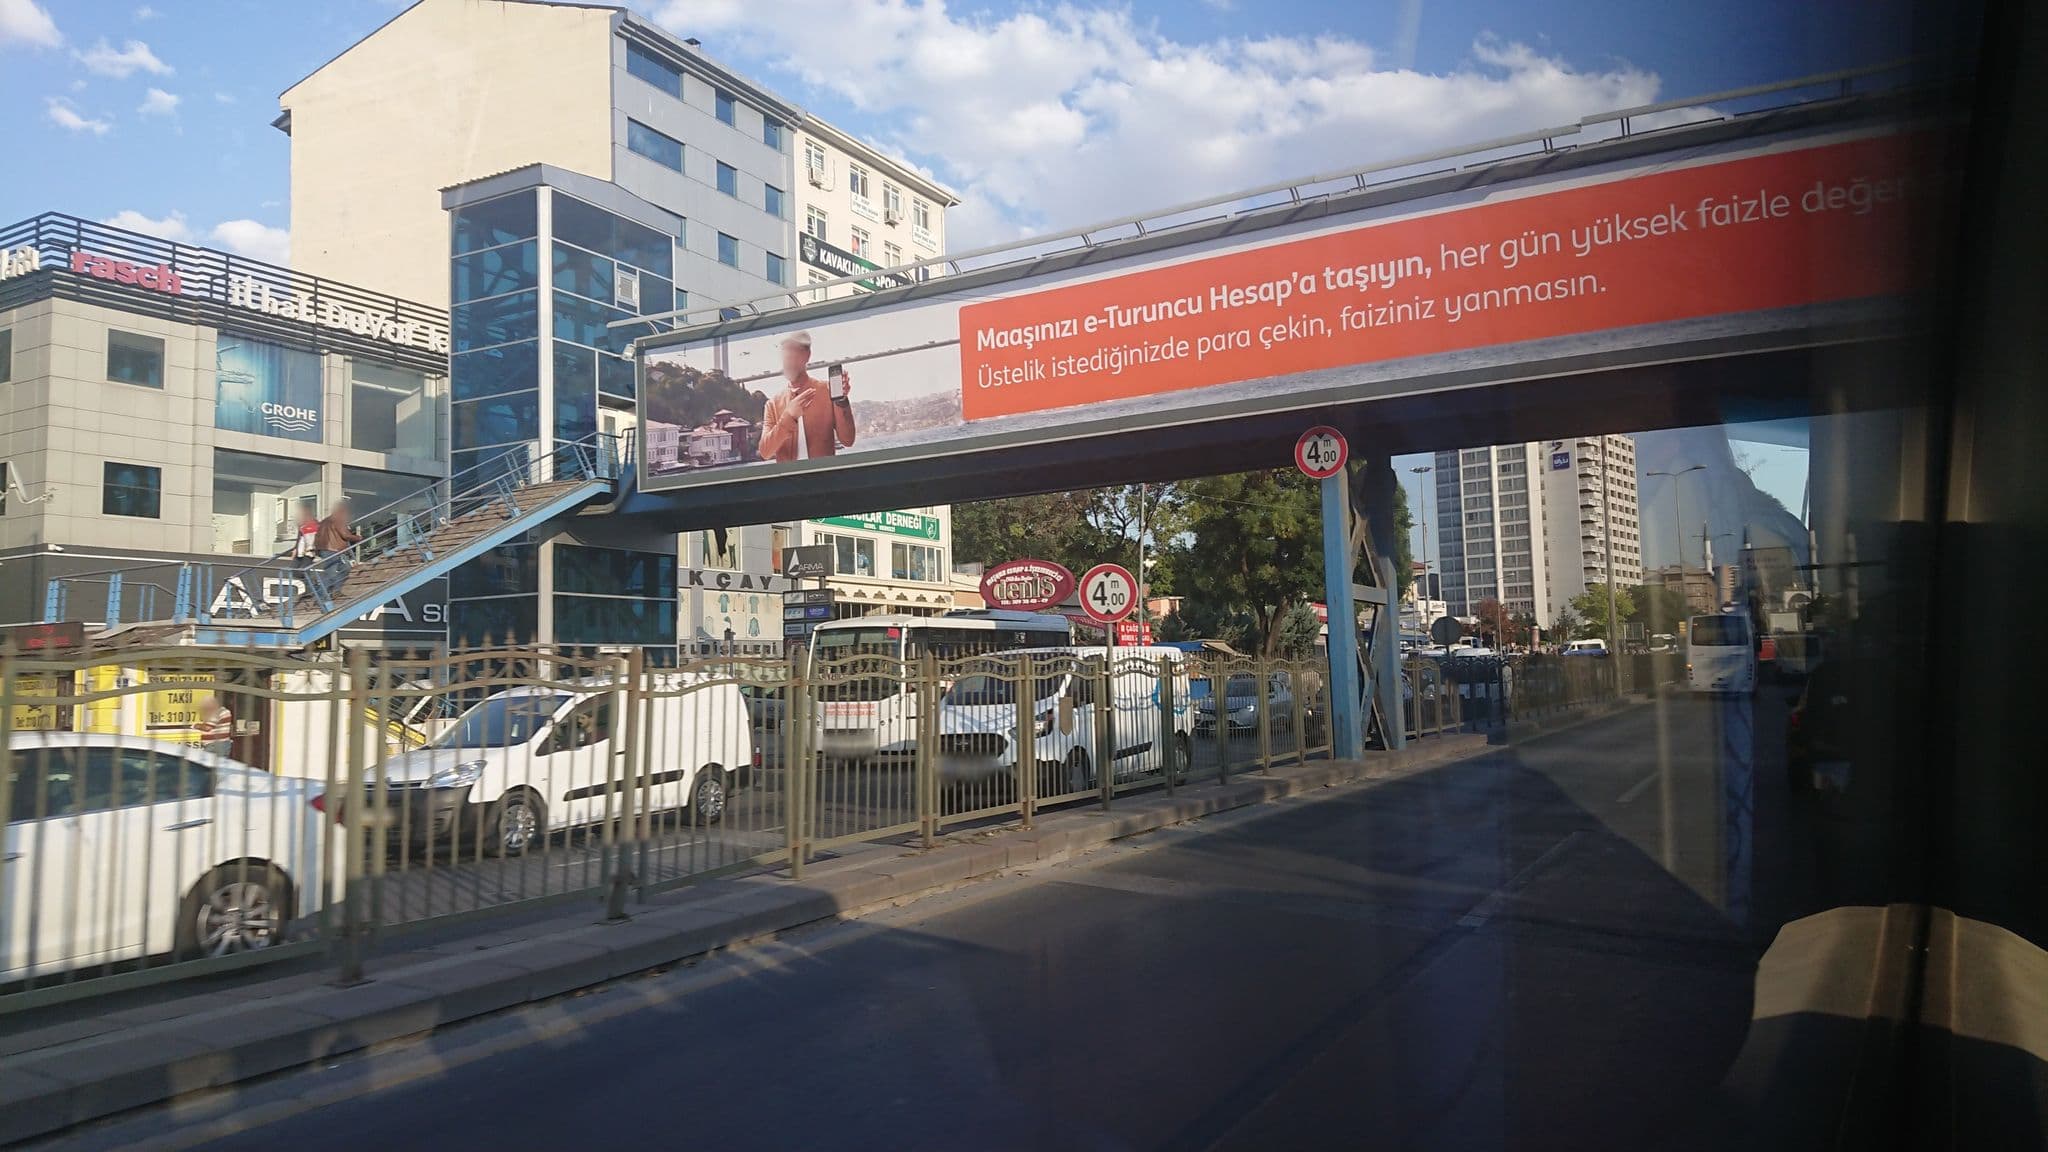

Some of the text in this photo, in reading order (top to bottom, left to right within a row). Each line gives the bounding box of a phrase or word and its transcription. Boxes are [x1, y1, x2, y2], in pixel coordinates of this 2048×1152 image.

[71, 250, 182, 295] rasch
[977, 318, 1078, 351] Maaşınızı
[1084, 295, 1203, 334] e-Turuncu
[1210, 271, 1317, 311] Hesap'a
[1323, 256, 1432, 292] taşıyın,
[1440, 243, 1491, 272] her
[1500, 230, 1561, 269] gün
[1571, 203, 1689, 258] yüksek
[1696, 189, 1791, 230] faizle
[977, 273, 1608, 389] Üstelik istediğinizde para çekin, faiziniz yanmasın.
[261, 402, 317, 422] GROHE
